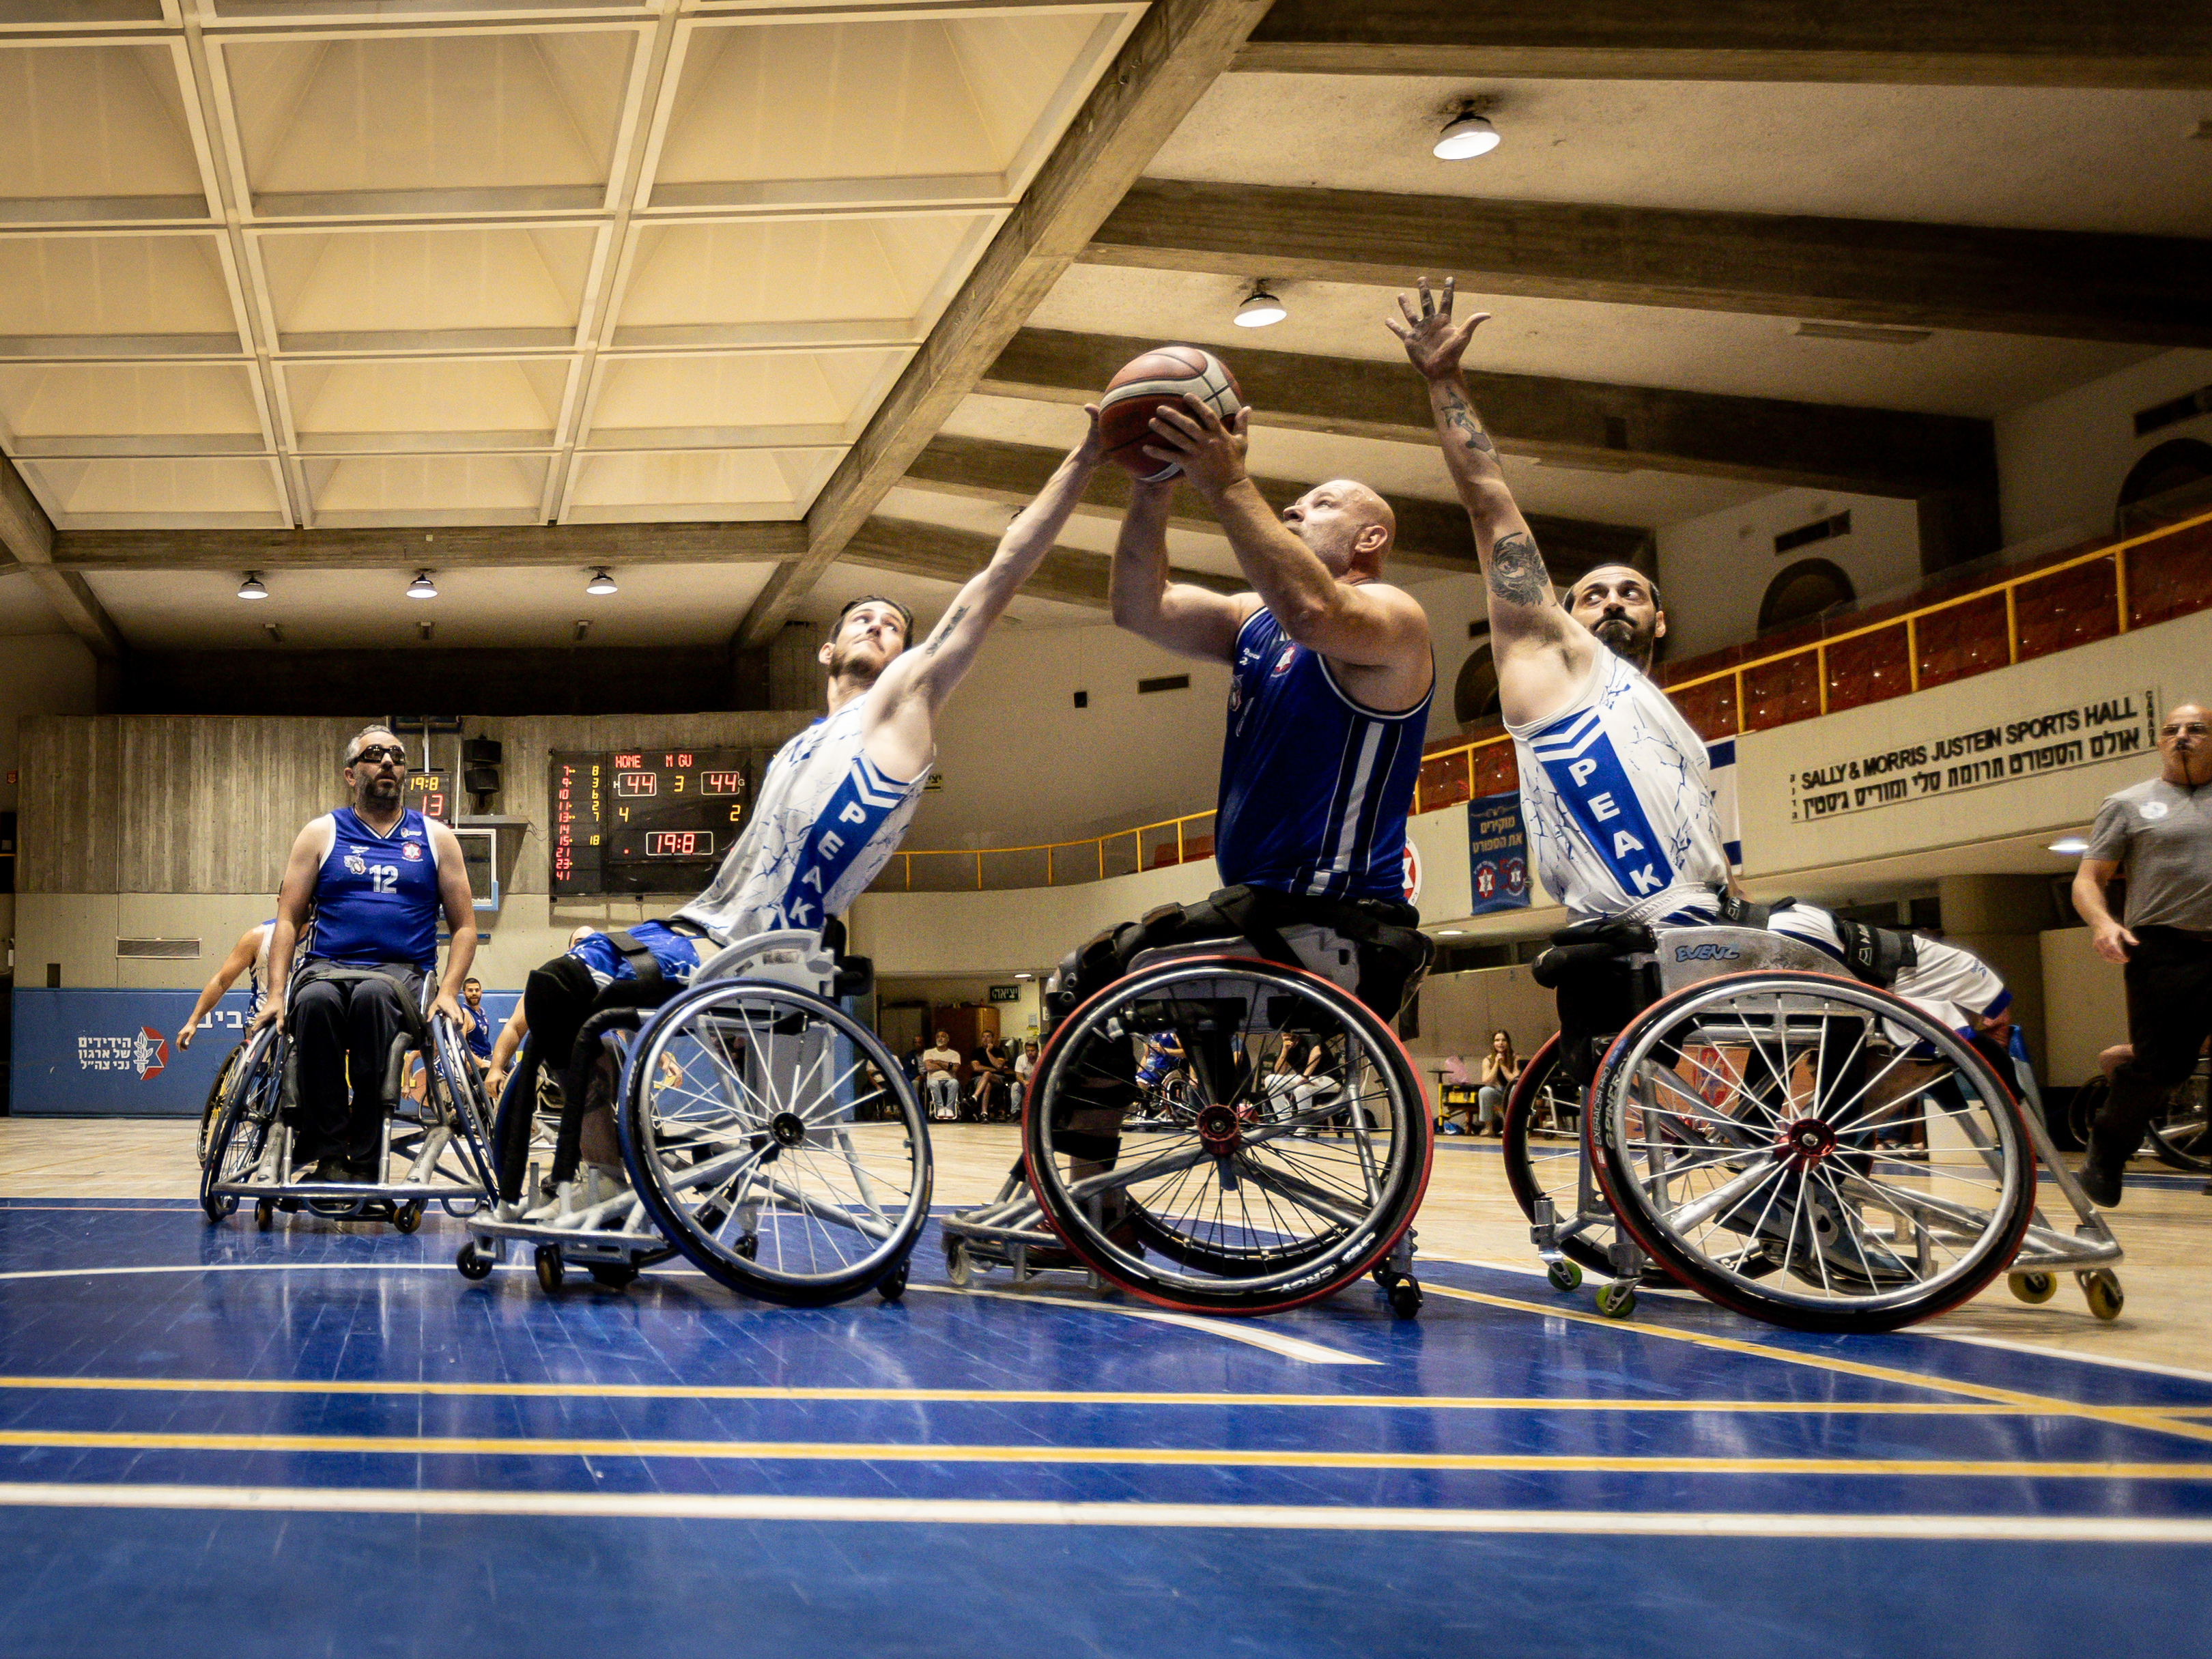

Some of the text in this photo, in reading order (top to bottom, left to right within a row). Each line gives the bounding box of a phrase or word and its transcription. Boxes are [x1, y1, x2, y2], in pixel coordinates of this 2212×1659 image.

[1801, 696, 2138, 789] SALLY & MORRIS JUSTEIN SPORTS HALL
[2089, 726, 2140, 758] אולם
[616, 755, 641, 768] HOME
[563, 766, 599, 776] 7 8
[410, 777, 438, 791] 19:8
[562, 778, 599, 787] 9 3
[627, 776, 653, 793] 44
[675, 776, 684, 792] 3
[711, 774, 737, 792] 44
[1911, 771, 1941, 793] סלי
[559, 790, 599, 799] 10 6
[1854, 778, 1908, 806] ומוריס
[422, 794, 443, 816] 13
[559, 801, 599, 810] 11 2
[558, 812, 599, 822] 13 7
[619, 805, 740, 822] 4 2
[559, 825, 569, 834] 14
[1568, 758, 1663, 894] PEAK
[560, 835, 599, 846] 15 18
[657, 834, 694, 853] 19:8
[1508, 832, 1522, 847] את
[556, 848, 570, 857] 21
[556, 860, 570, 869] 23
[789, 802, 866, 926] PEAK
[369, 864, 399, 894] 12
[556, 872, 570, 880] 41
[78, 1037, 131, 1048] הידידים
[78, 1048, 131, 1060] של ארגון
[113, 1060, 130, 1070] נכי
